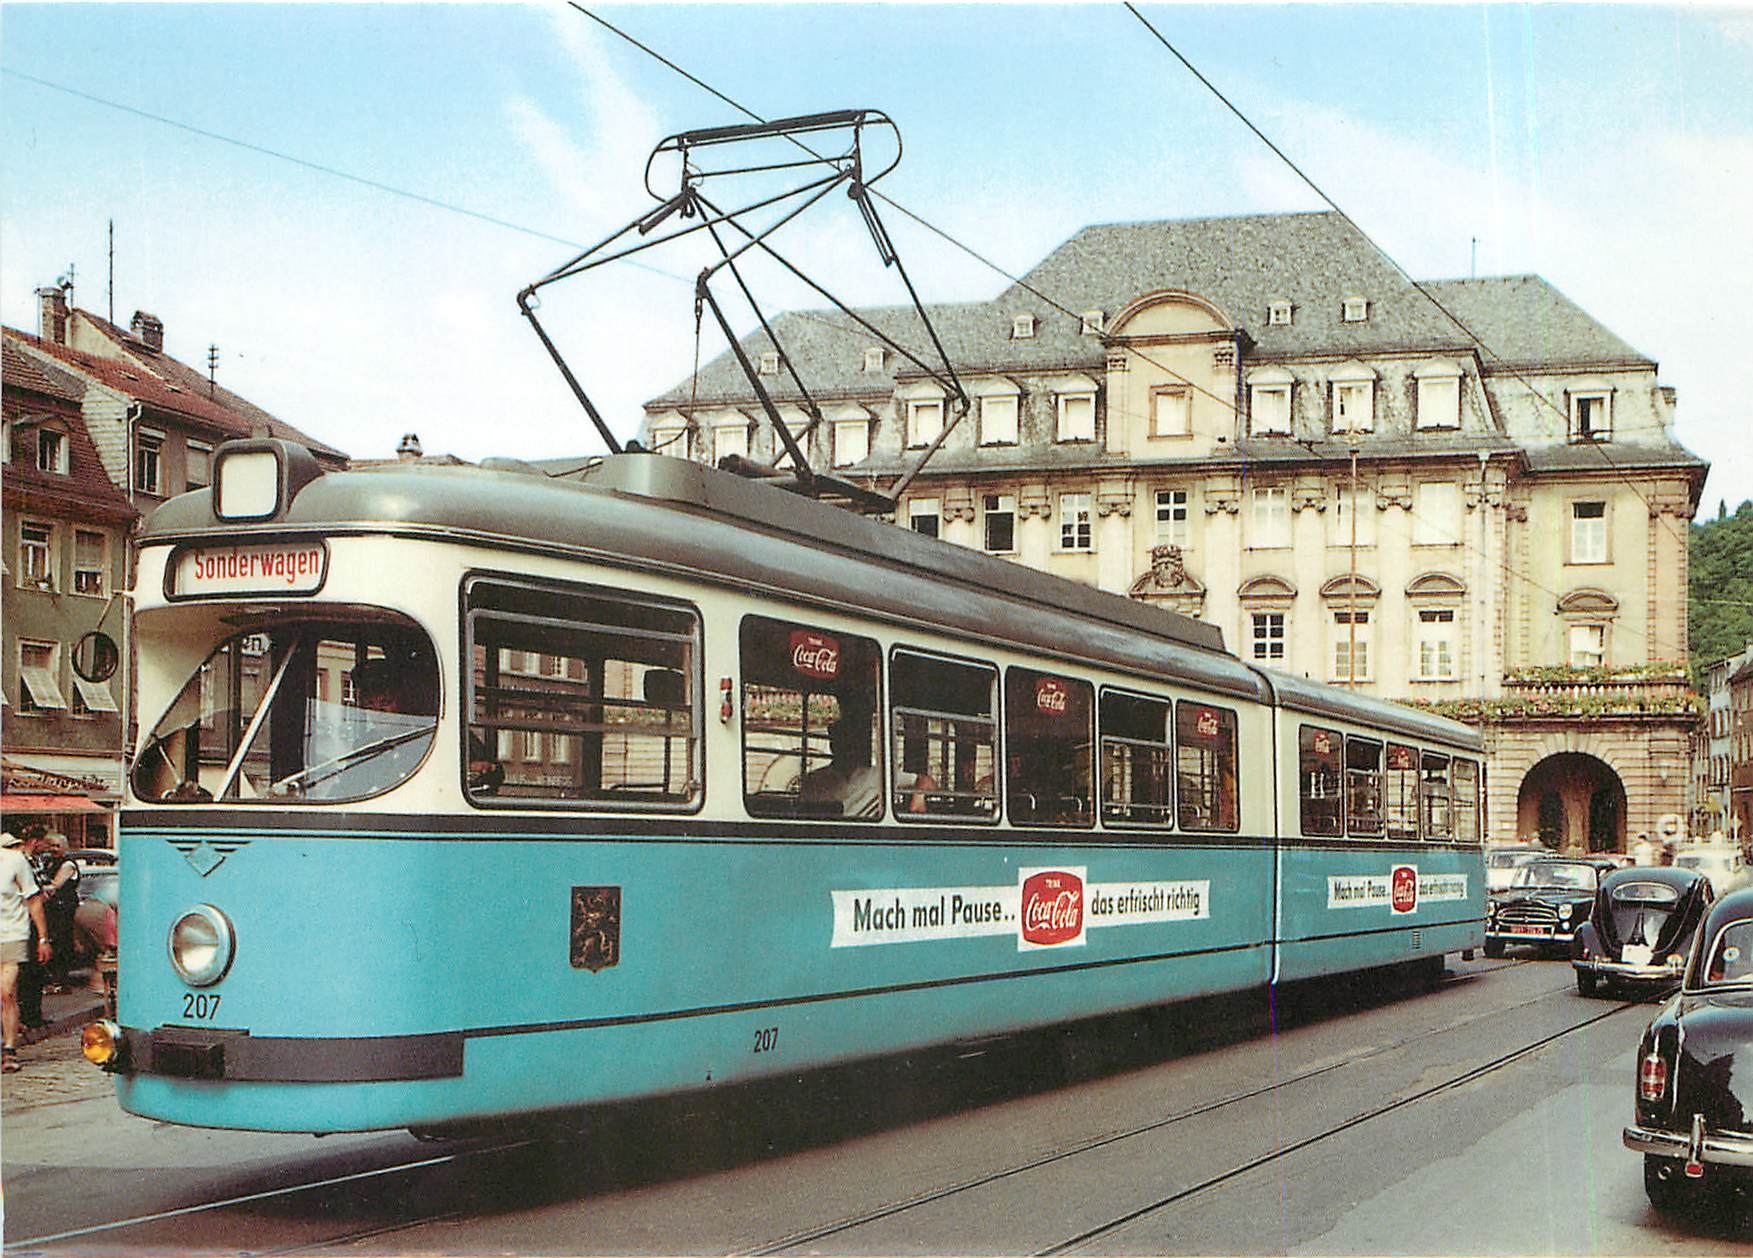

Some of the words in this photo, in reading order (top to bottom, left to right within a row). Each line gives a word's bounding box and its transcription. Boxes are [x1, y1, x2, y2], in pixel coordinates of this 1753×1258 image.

[194, 549, 320, 584] Sonderwagen
[853, 897, 906, 932] Mach
[912, 895, 945, 928] mal
[1091, 889, 1114, 915] das
[1117, 886, 1165, 914] erfrischt
[1167, 886, 1200, 916] richtig
[183, 993, 222, 1020] 207
[754, 1027, 779, 1054] 207
